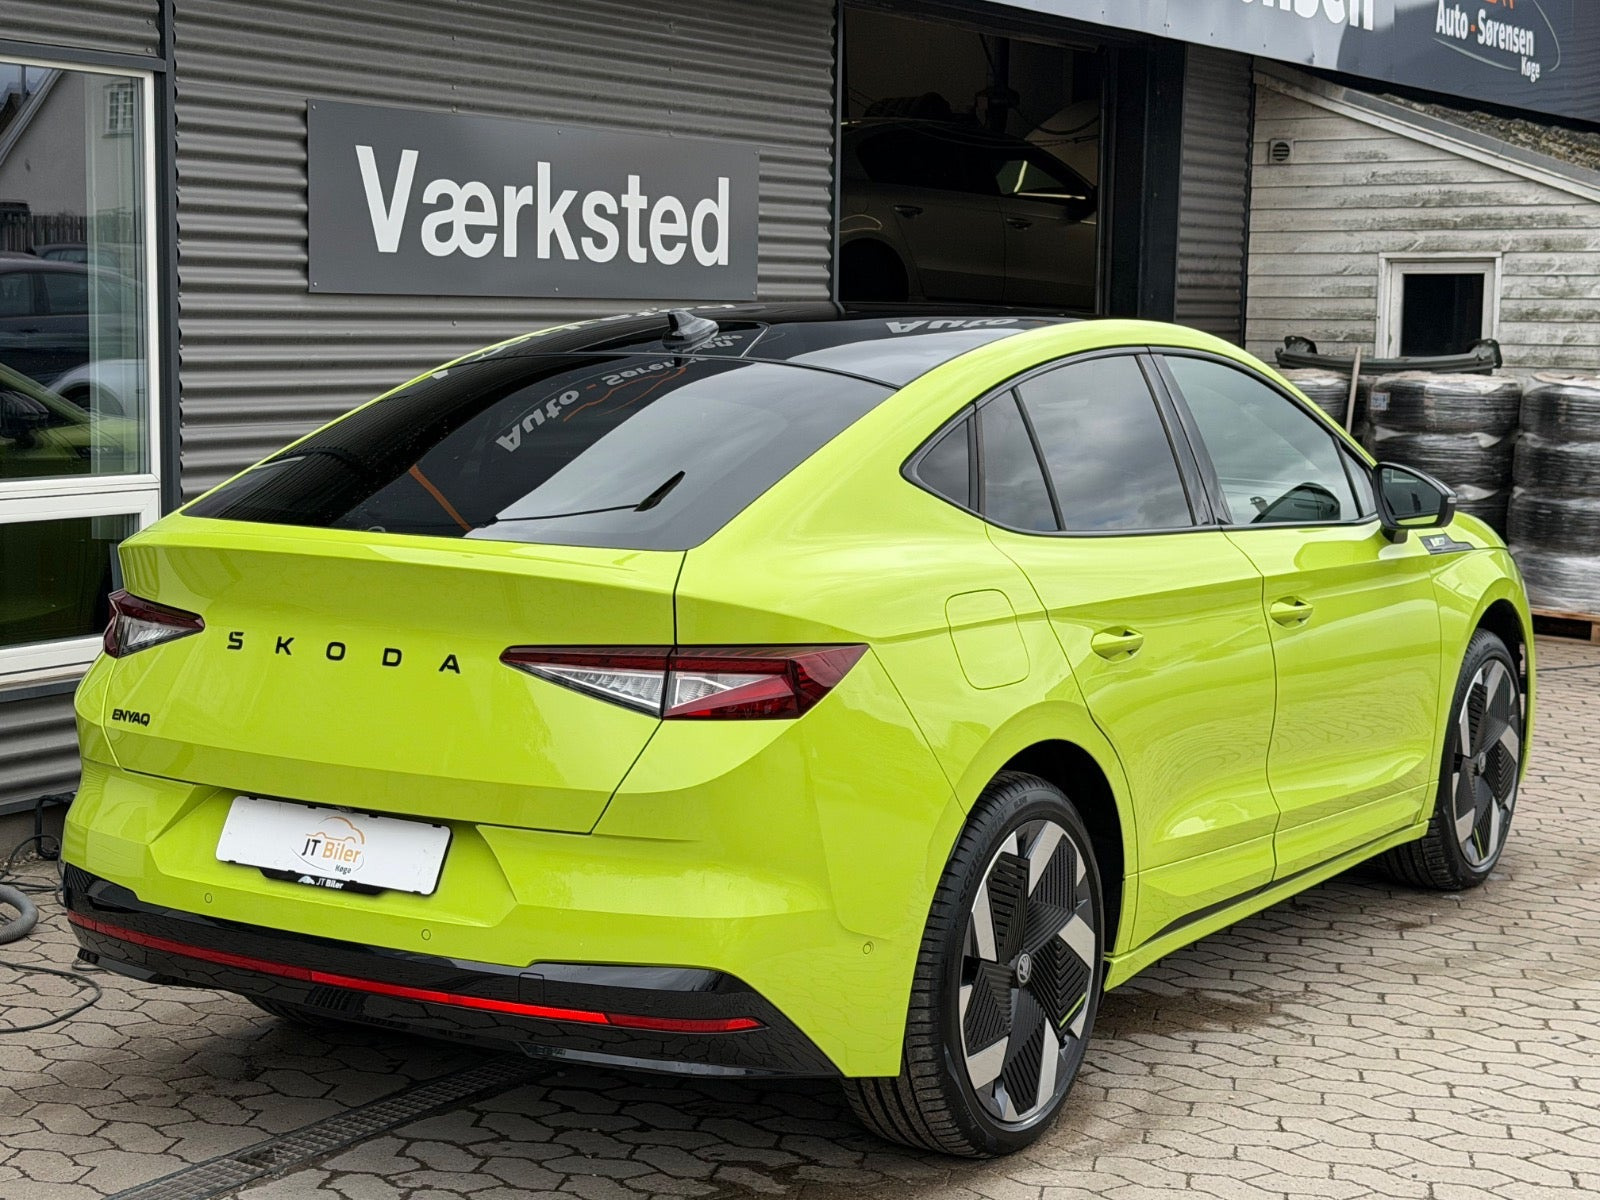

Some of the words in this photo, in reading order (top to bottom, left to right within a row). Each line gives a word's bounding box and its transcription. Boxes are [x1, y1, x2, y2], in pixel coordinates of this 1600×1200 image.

[1435, 0, 1469, 40] Auto
[1477, 8, 1534, 57] Sørensen
[1521, 56, 1540, 83] Køge
[355, 144, 730, 267] Værksted
[227, 631, 461, 674] SKODA
[112, 708, 151, 727] ENYAQ
[301, 838, 322, 857] JT
[322, 841, 362, 863] Biler
